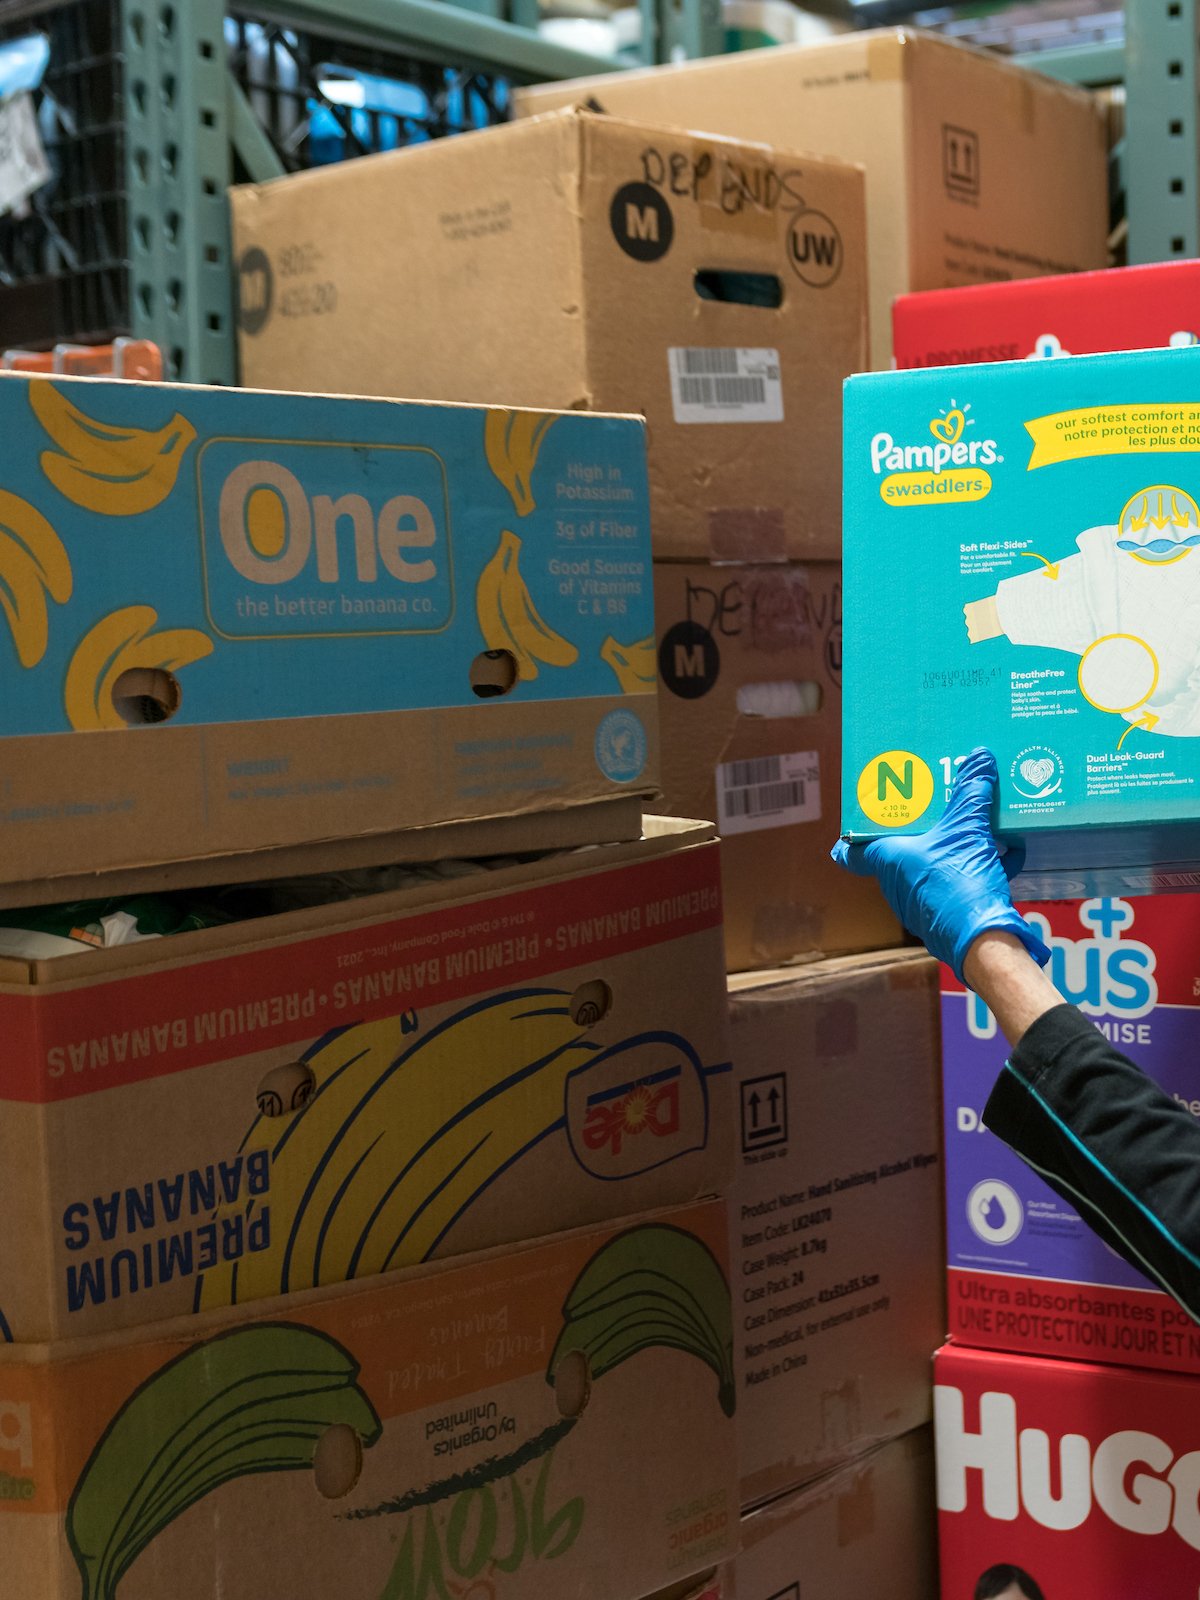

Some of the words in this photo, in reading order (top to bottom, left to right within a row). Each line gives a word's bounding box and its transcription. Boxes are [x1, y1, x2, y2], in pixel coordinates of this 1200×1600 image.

[641, 148, 806, 214] DEPENDS
[626, 203, 659, 242] M
[793, 231, 835, 266] UW
[1055, 418, 1077, 430] our
[1082, 411, 1126, 426] softest
[1132, 410, 1184, 421] comfort
[1065, 428, 1101, 441] notre
[1102, 424, 1168, 438] protection
[1172, 424, 1184, 434] et
[1129, 429, 1146, 446] les
[1150, 429, 1176, 446] plus
[568, 464, 603, 482] High
[608, 465, 621, 479] in
[556, 483, 633, 501] Potassium
[219, 459, 436, 584] One
[556, 521, 575, 540] 3g
[581, 521, 595, 538] of
[600, 522, 638, 538] Fiber
[960, 544, 978, 552] Soft
[549, 559, 590, 575] Good
[595, 560, 644, 574] Source
[560, 579, 574, 595] of
[580, 580, 641, 595] Vitamins
[236, 596, 269, 617] the
[274, 595, 335, 616] better
[341, 595, 407, 614] banana
[412, 598, 438, 612] co.
[578, 600, 587, 614] C
[674, 644, 706, 679] M
[1010, 670, 1065, 680] BreatheFree
[1016, 745, 1041, 759] HEALTH
[1043, 746, 1064, 774] ALLIANCE
[1087, 754, 1108, 763] Dual
[1110, 750, 1164, 762] Leak-Guard
[877, 759, 913, 801] N
[901, 811, 909, 819] kg
[1009, 801, 1066, 809] DERMATOLOGIST
[644, 886, 719, 927] PREMIUM
[556, 905, 641, 952] BANANAS
[445, 934, 539, 982] PREMIUM
[333, 957, 440, 1009] BANANAS
[195, 988, 316, 1044] PREMIUM
[1095, 1022, 1152, 1044] MISE
[47, 1018, 187, 1078] BANANAS
[582, 1080, 681, 1156] Dole
[61, 1149, 271, 1251] BANANAS
[741, 1199, 777, 1220] Product
[808, 1183, 832, 1200] Hand
[834, 1170, 877, 1192] Sanitizing
[879, 1159, 912, 1178] Alcohol
[913, 1153, 938, 1168] Wipes
[65, 1206, 272, 1313] PREMIUM
[957, 1279, 1010, 1304] Ultra
[1015, 1285, 1155, 1322] absorbantes
[957, 1306, 992, 1333] UNE
[996, 1309, 1107, 1347] PROTECTION
[1111, 1325, 1159, 1352] JOUR
[1160, 1331, 1185, 1355] ET
[746, 1369, 770, 1388] Made
[772, 1365, 780, 1376] in
[782, 1354, 807, 1372] China
[426, 1401, 497, 1440] Unlimited
[499, 1417, 516, 1434] by
[433, 1426, 498, 1456] Organics
